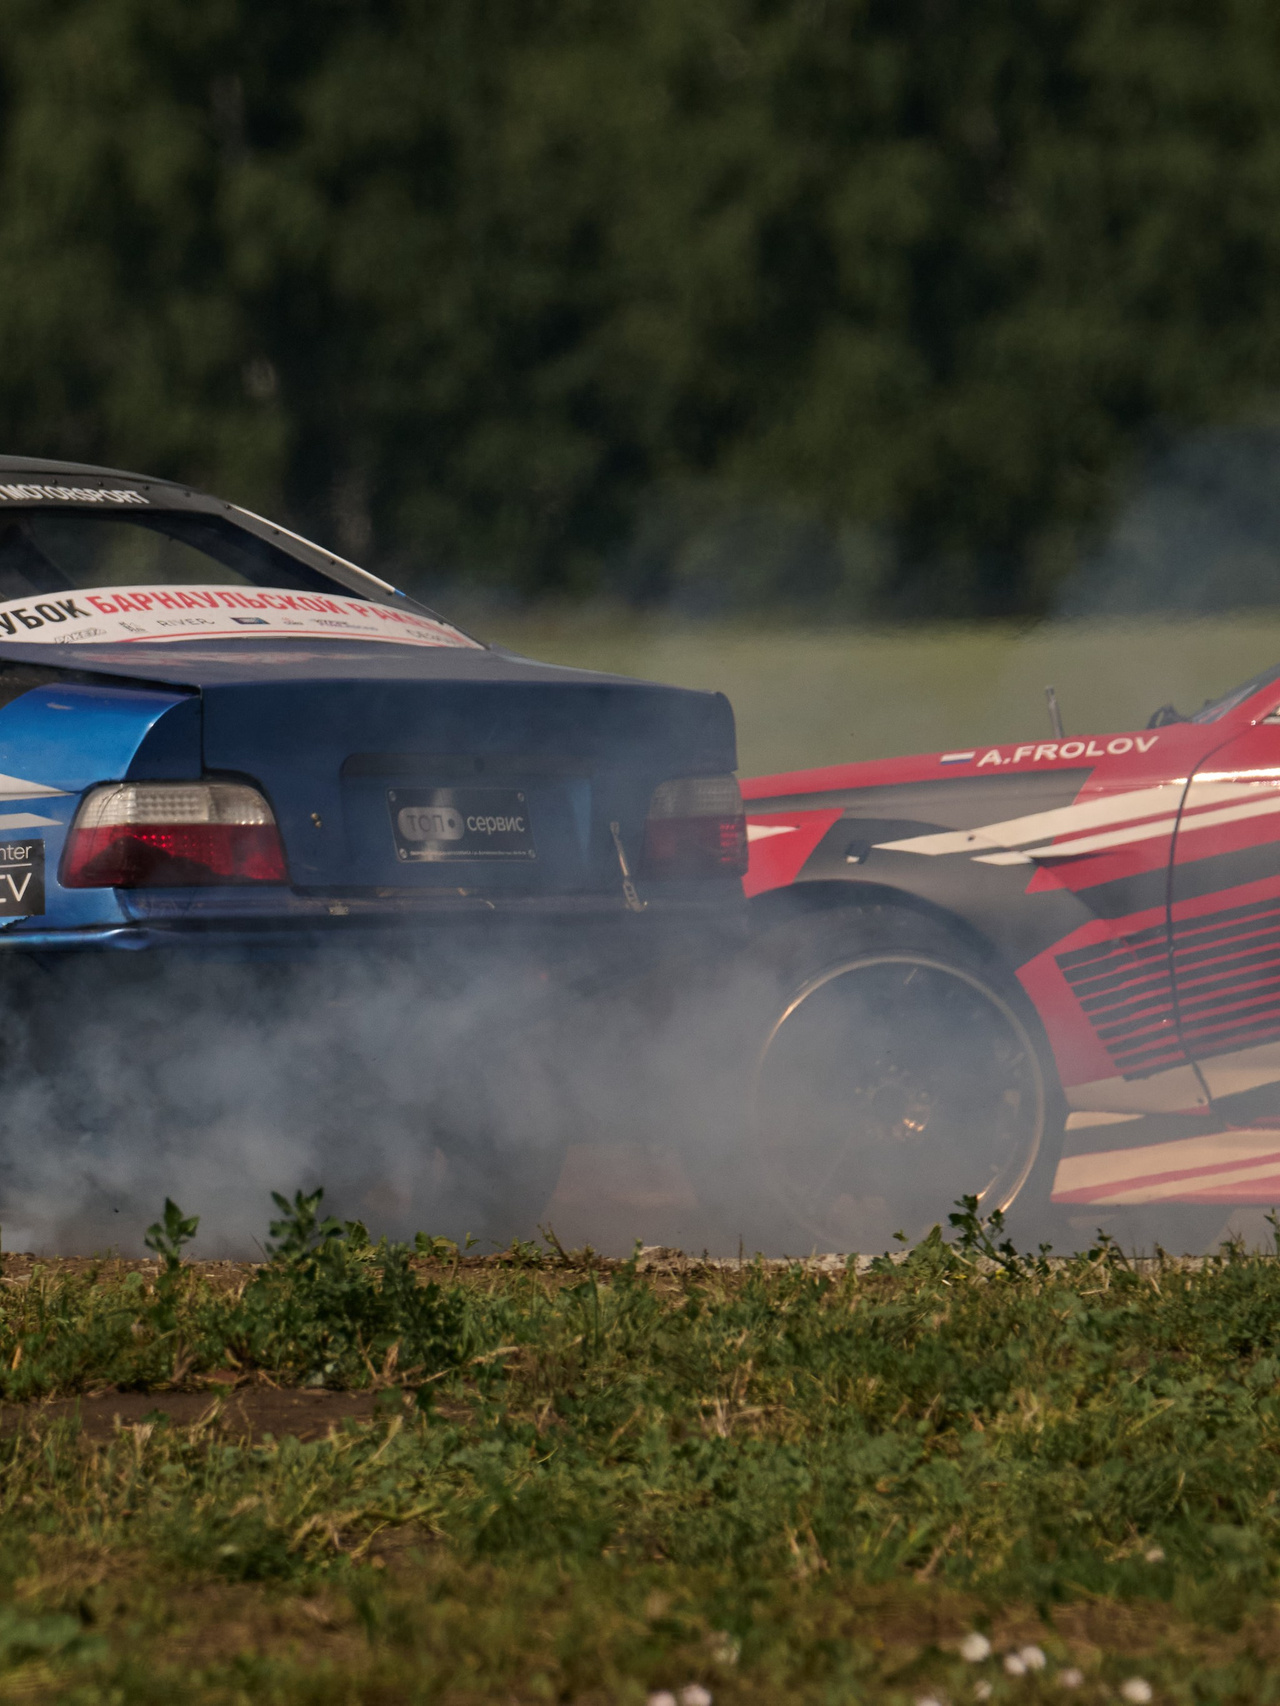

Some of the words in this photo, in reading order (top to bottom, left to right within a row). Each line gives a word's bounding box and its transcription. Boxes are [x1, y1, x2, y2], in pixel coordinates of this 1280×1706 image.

[85, 591, 349, 616] БАРНАУЛЬСКОЙ
[156, 618, 216, 628] RIVER
[976, 735, 1160, 767] A.FROLOV
[466, 816, 526, 835] сервис
